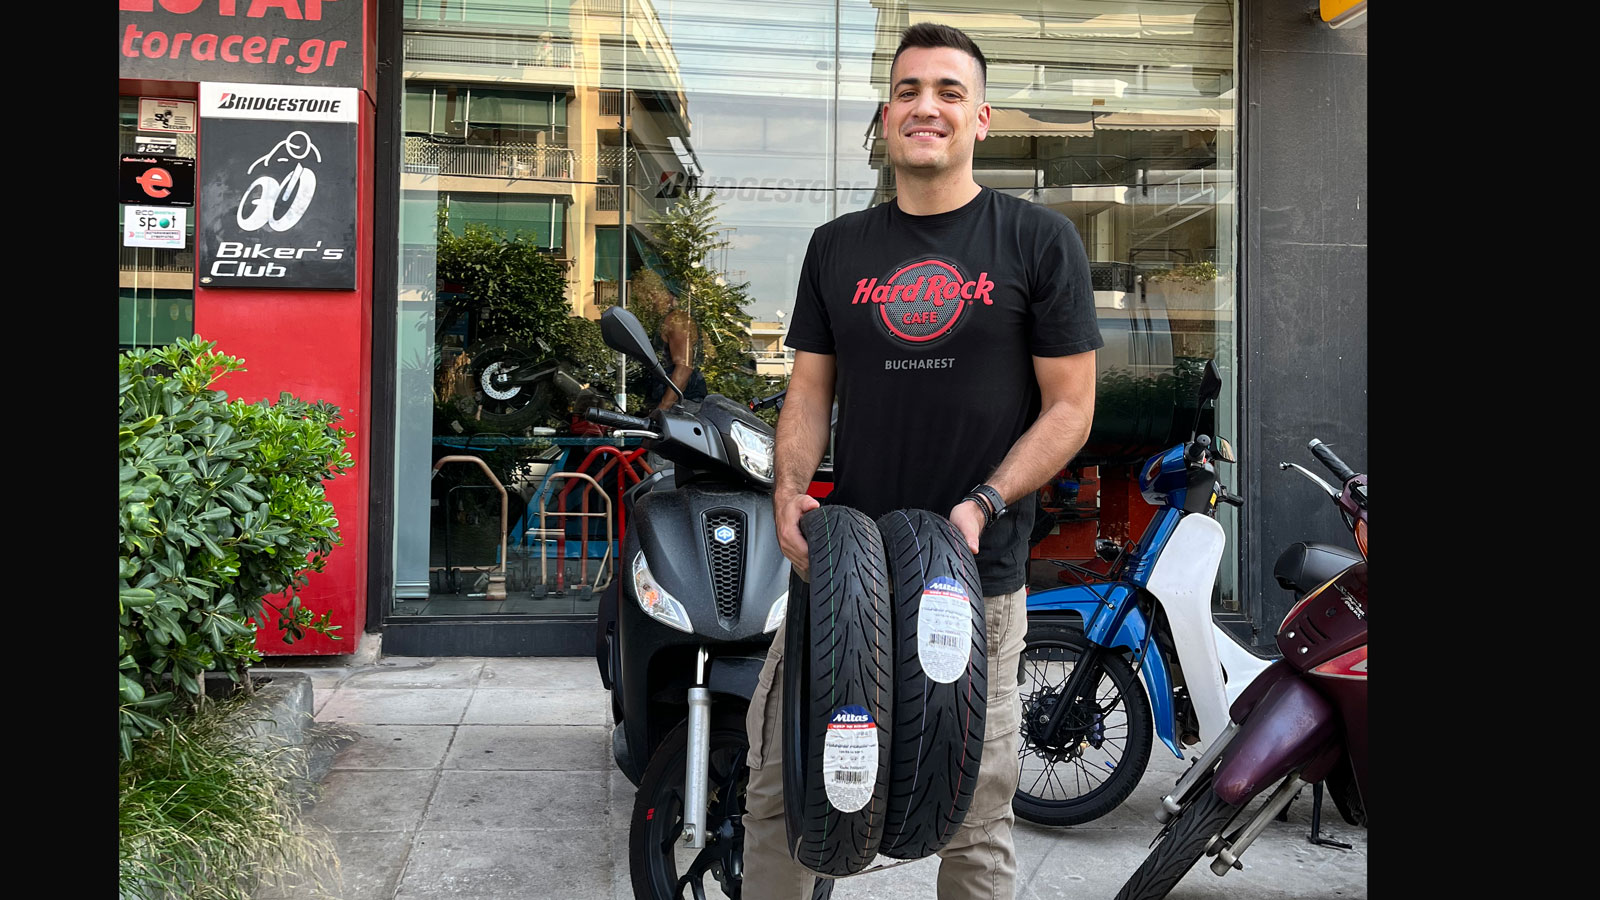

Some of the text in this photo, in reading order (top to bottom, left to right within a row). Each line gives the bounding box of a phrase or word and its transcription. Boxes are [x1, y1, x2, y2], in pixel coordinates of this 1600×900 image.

[121, 24, 348, 74] toracer.gr
[217, 93, 341, 113] BRIDGESTONE
[139, 215, 176, 230] spot
[216, 240, 344, 260] Biker's
[210, 260, 287, 278] Club
[851, 272, 995, 307] Hard Rock
[902, 311, 938, 325] CAFE
[884, 358, 956, 370] BUCHAREST
[929, 582, 964, 594] Mitas
[832, 713, 869, 723] Mitas
